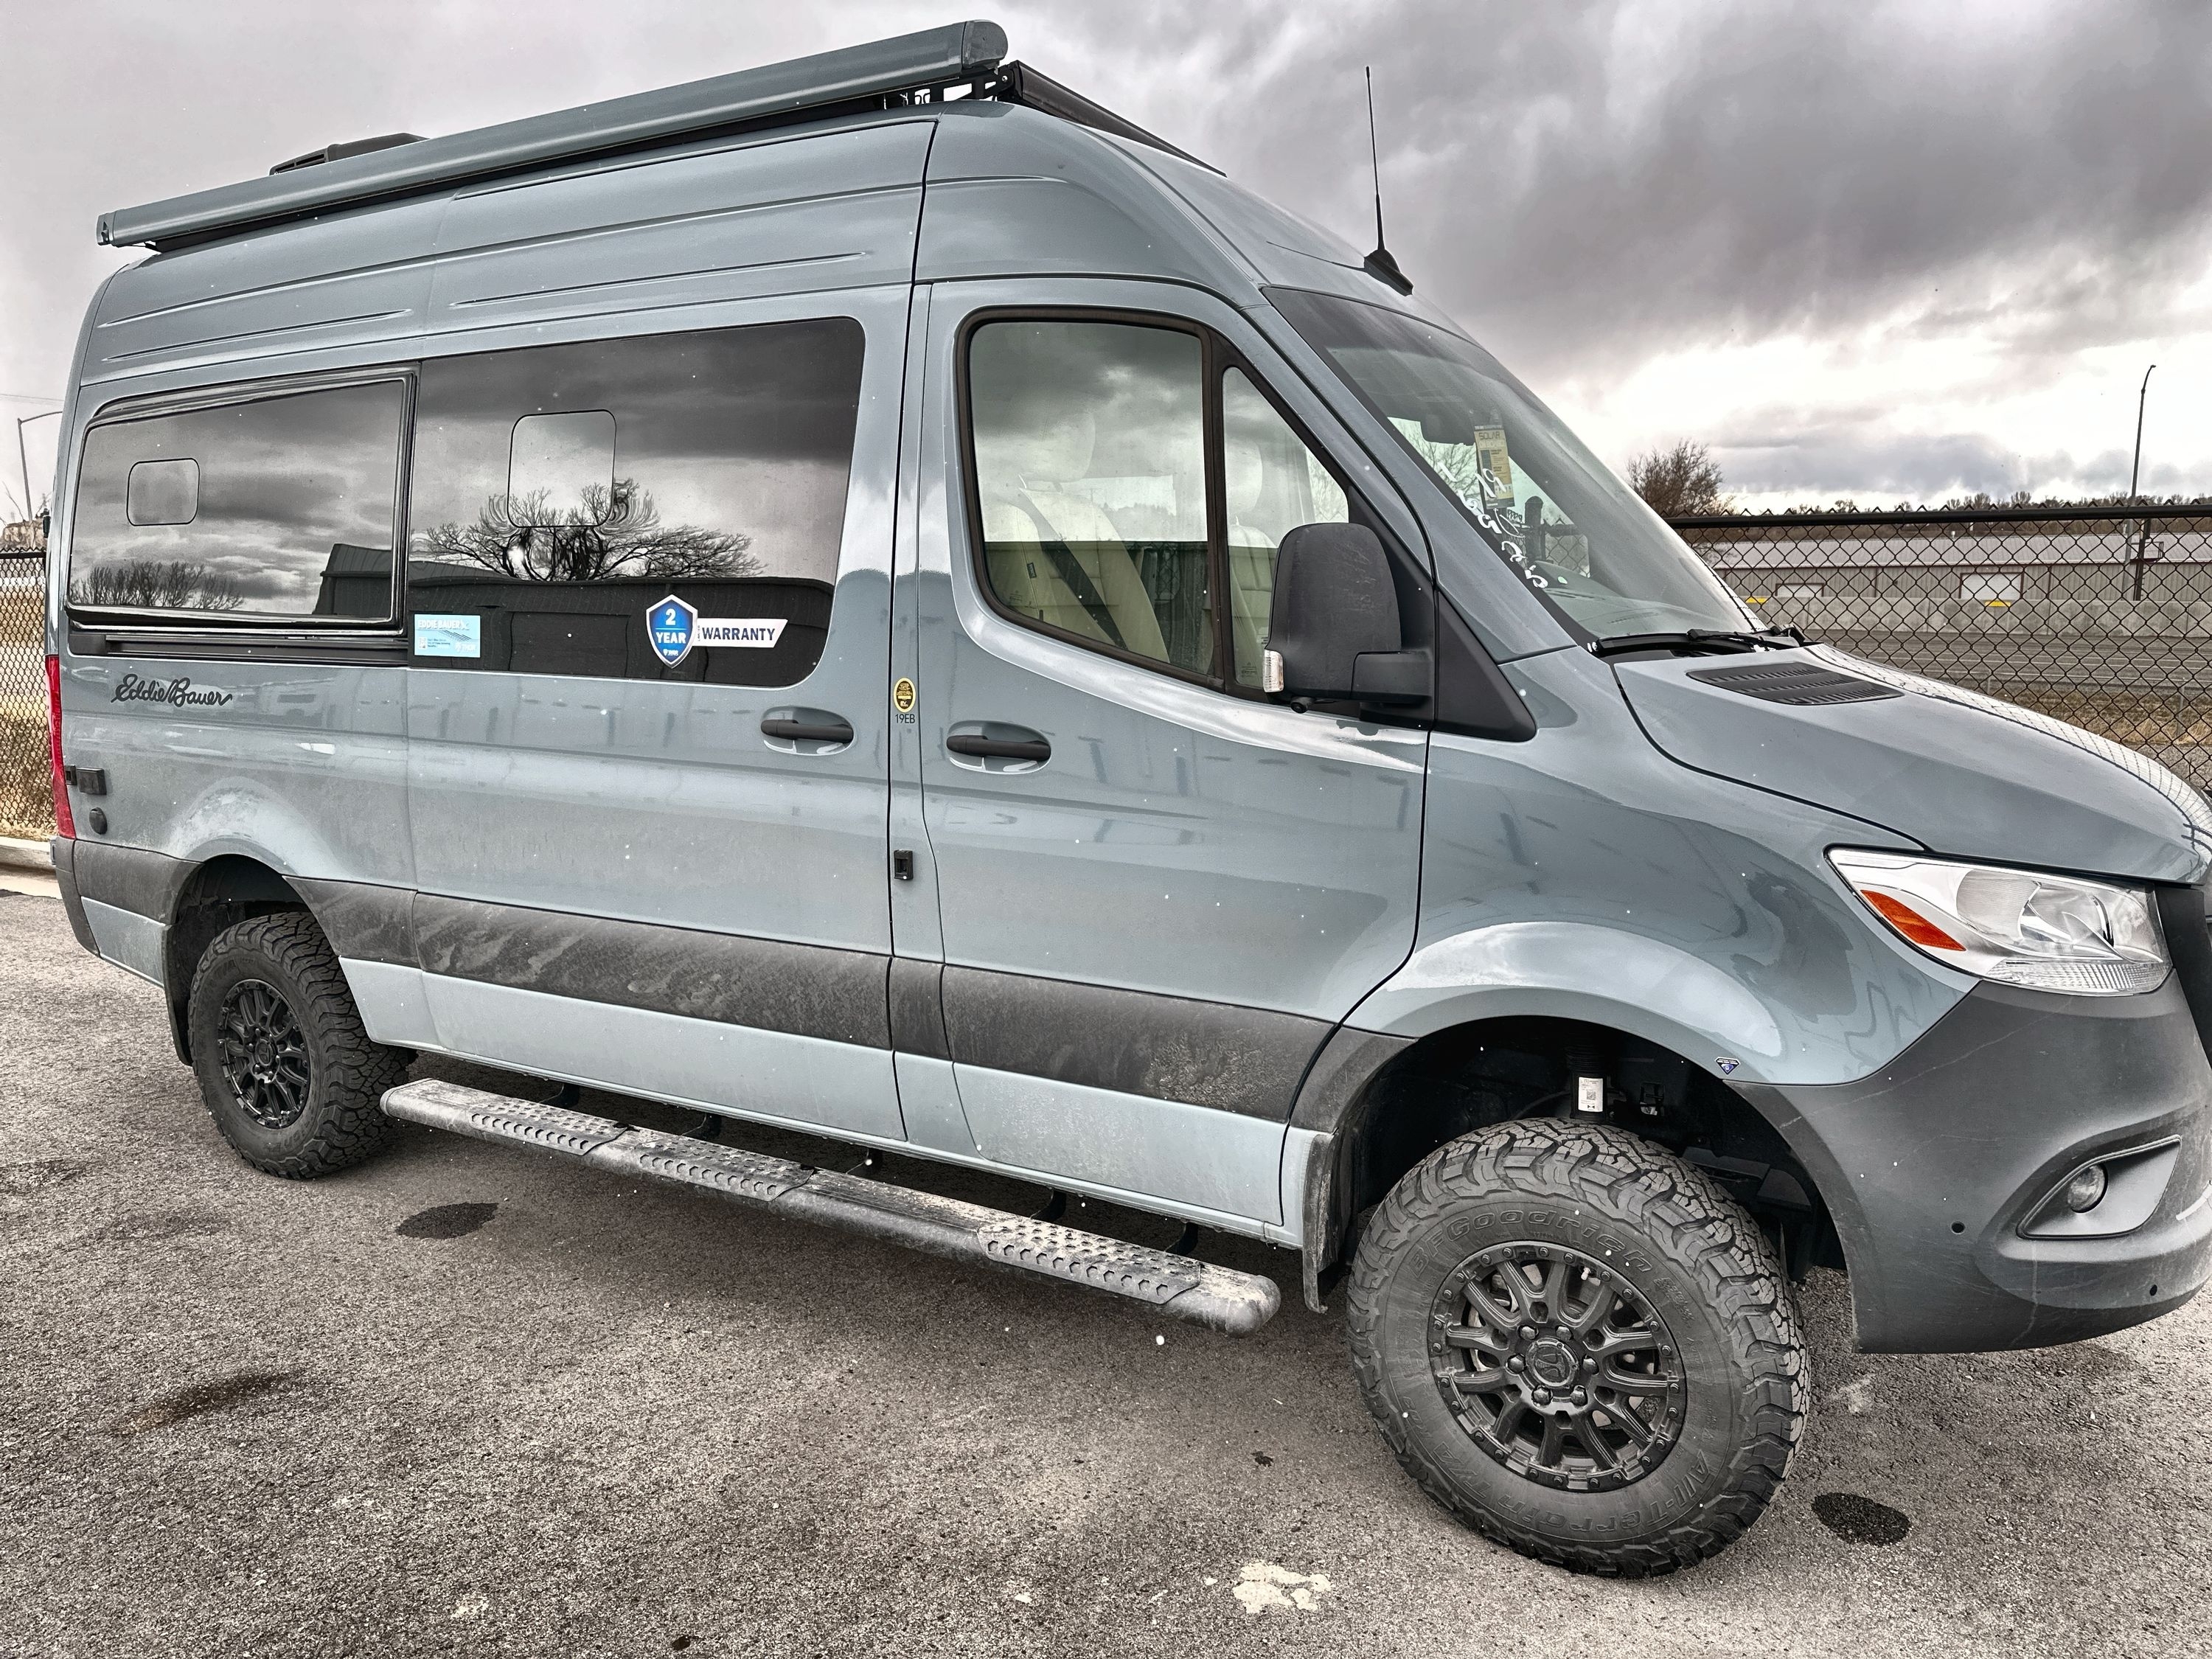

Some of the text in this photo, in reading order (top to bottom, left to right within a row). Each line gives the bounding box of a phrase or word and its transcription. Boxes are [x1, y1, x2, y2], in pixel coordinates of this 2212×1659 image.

[1478, 431, 1500, 440] SOLAR
[665, 608, 676, 625] 2
[417, 619, 461, 630] EDDIE BAUER
[655, 632, 686, 644] YEAR
[702, 627, 775, 641] WARRANTY
[111, 673, 233, 707] Eddie Bauer
[894, 713, 916, 724] 19EB
[1409, 1209, 1652, 1279] BFGoodrich
